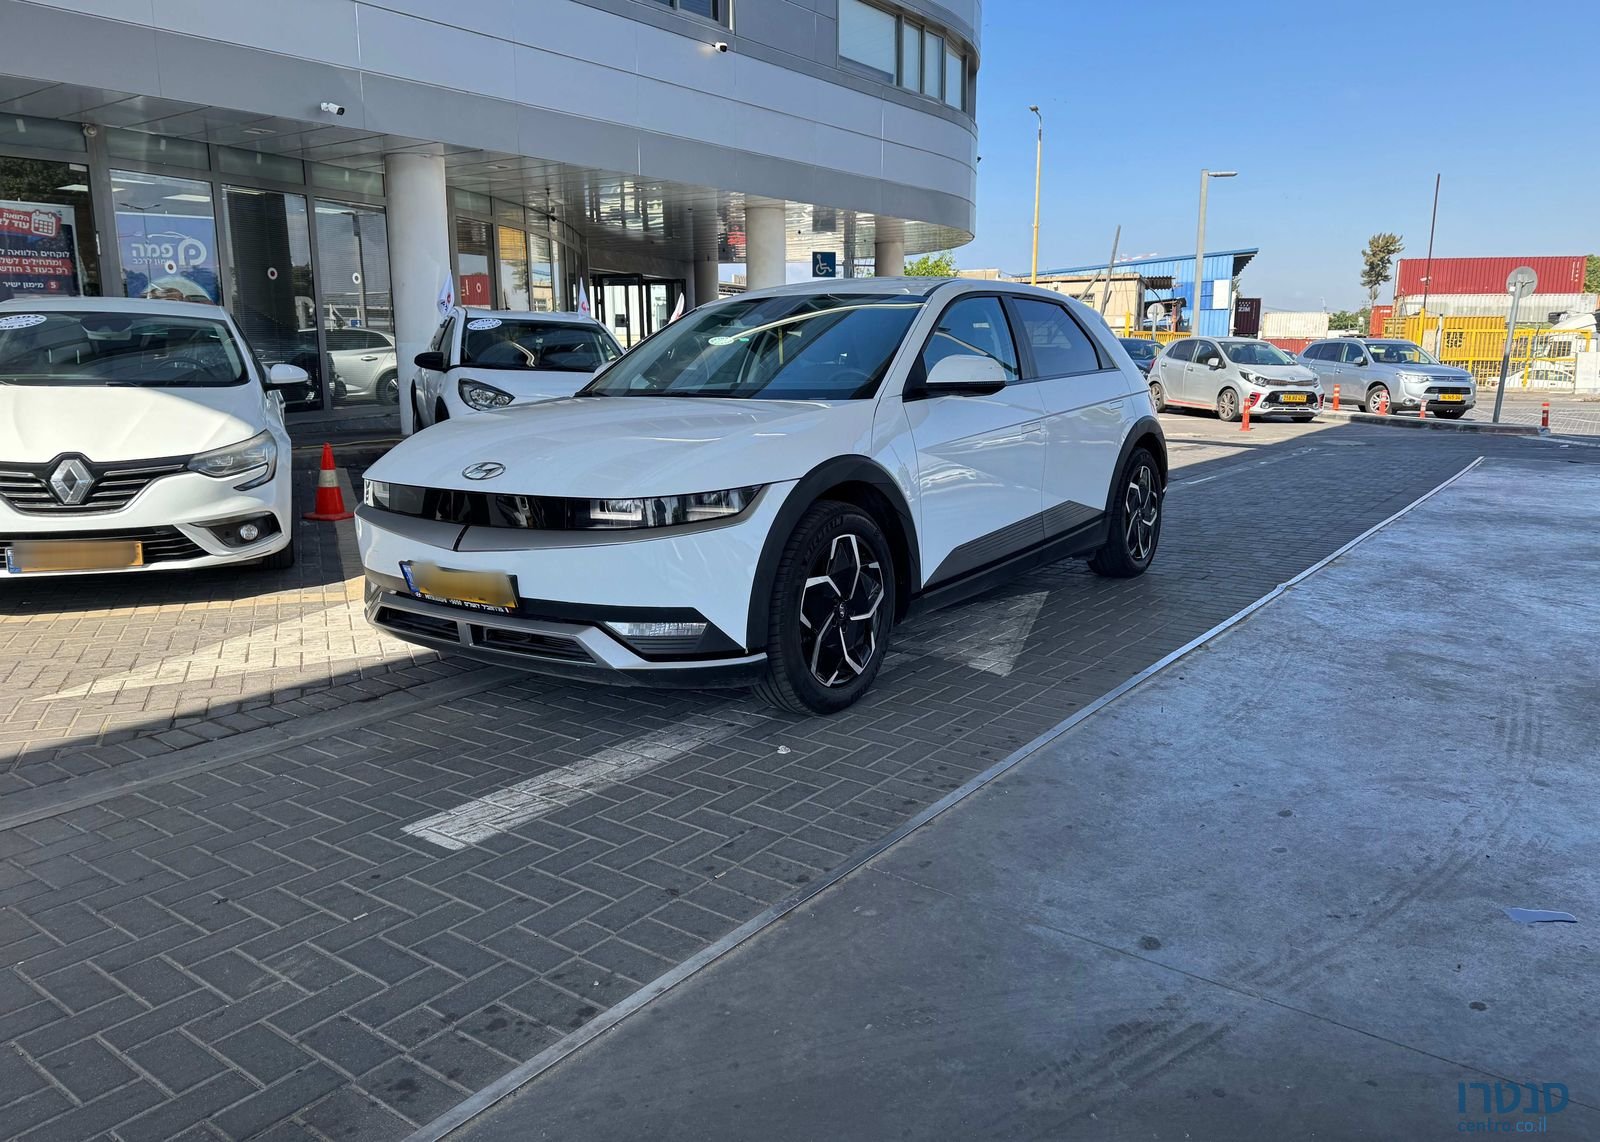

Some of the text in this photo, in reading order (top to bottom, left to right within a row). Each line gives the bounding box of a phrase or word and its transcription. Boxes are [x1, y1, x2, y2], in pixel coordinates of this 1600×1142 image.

[11, 220, 30, 229] עוד
[8, 249, 38, 257] הלוואה
[40, 250, 70, 258] לוקחים
[131, 243, 174, 258] פמה
[22, 258, 62, 266] ומתחילים
[32, 266, 54, 274] בעוד
[56, 267, 68, 275] רק
[3, 281, 21, 289] ישיר
